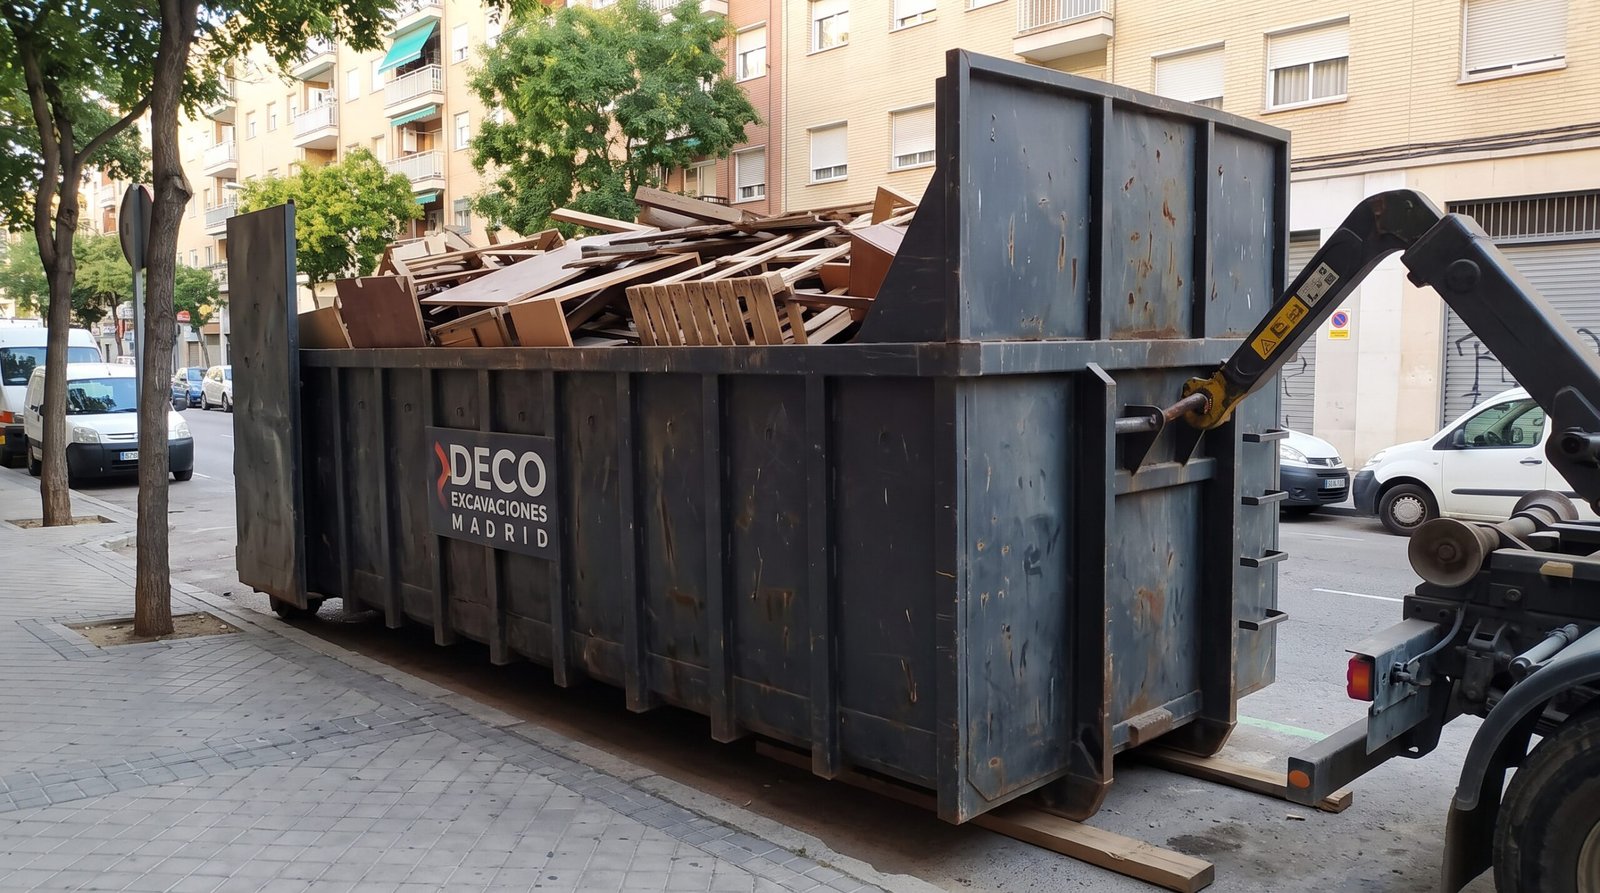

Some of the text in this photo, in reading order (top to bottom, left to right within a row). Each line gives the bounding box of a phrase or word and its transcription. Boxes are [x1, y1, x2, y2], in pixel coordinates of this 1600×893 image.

[450, 444, 546, 497] DECO
[451, 491, 547, 523] EXCAVACIONES
[452, 513, 548, 548] MADRID
